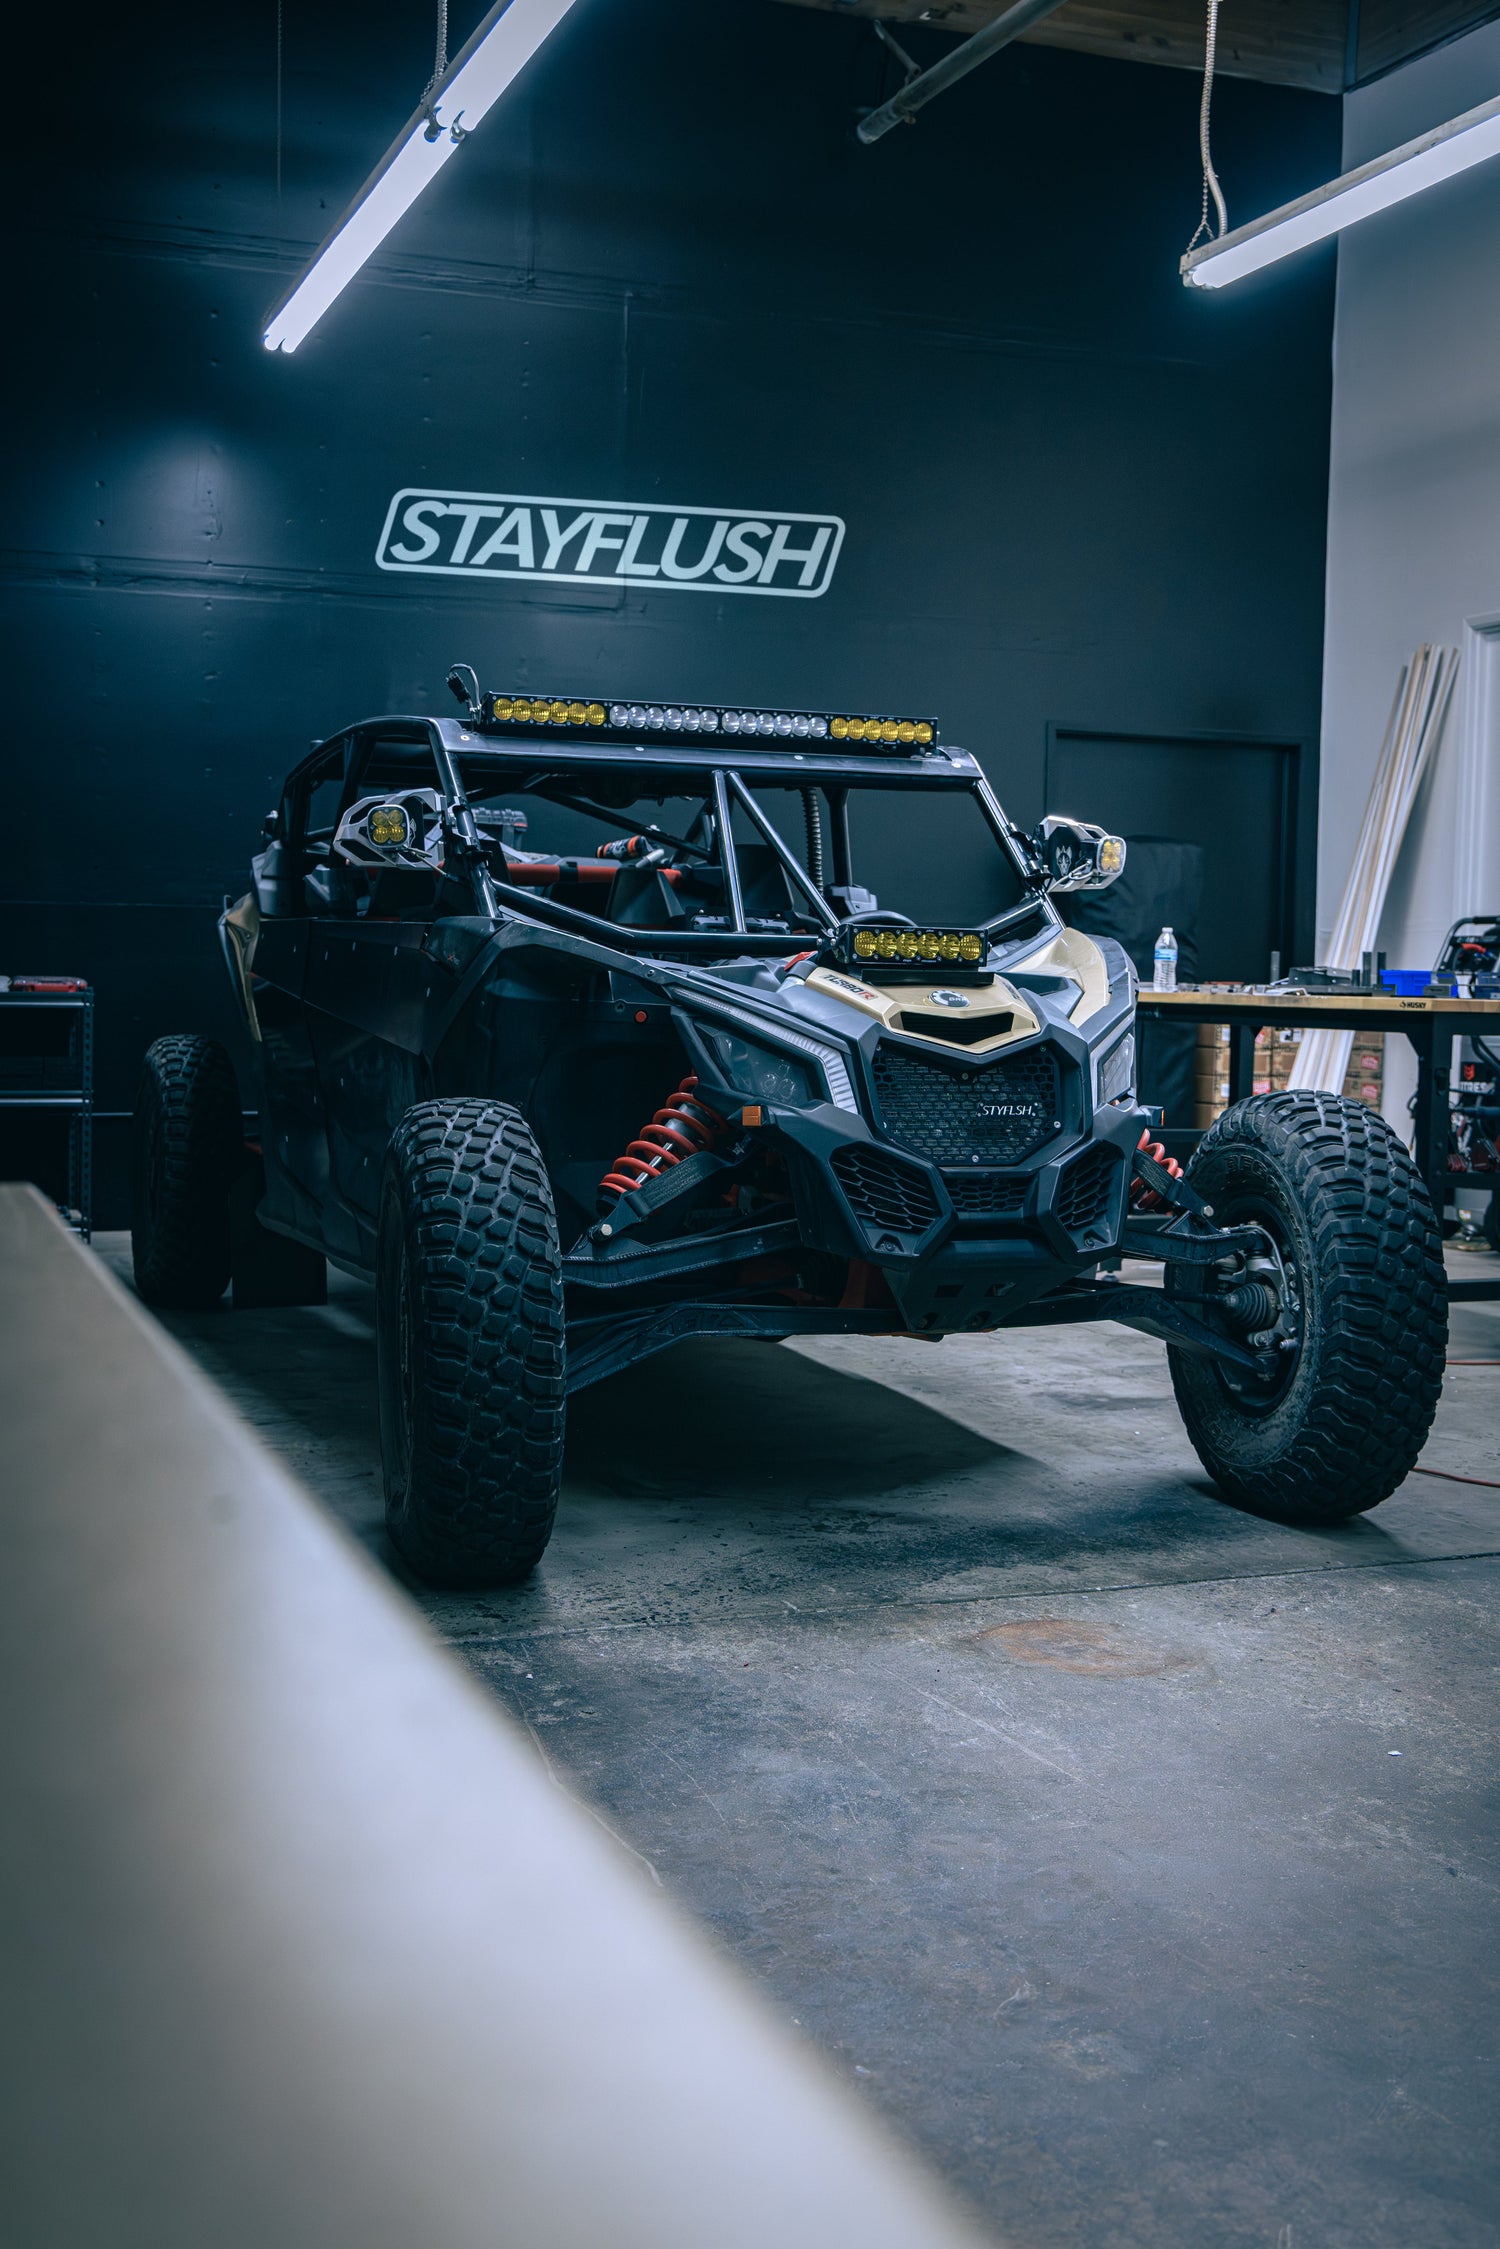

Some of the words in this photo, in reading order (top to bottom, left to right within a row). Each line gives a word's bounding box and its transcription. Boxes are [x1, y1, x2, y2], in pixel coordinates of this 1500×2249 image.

[390, 500, 832, 587] STAYFLUSH
[1407, 1001, 1427, 1009] HUSKY
[982, 1105, 1033, 1116] STYFLSH
